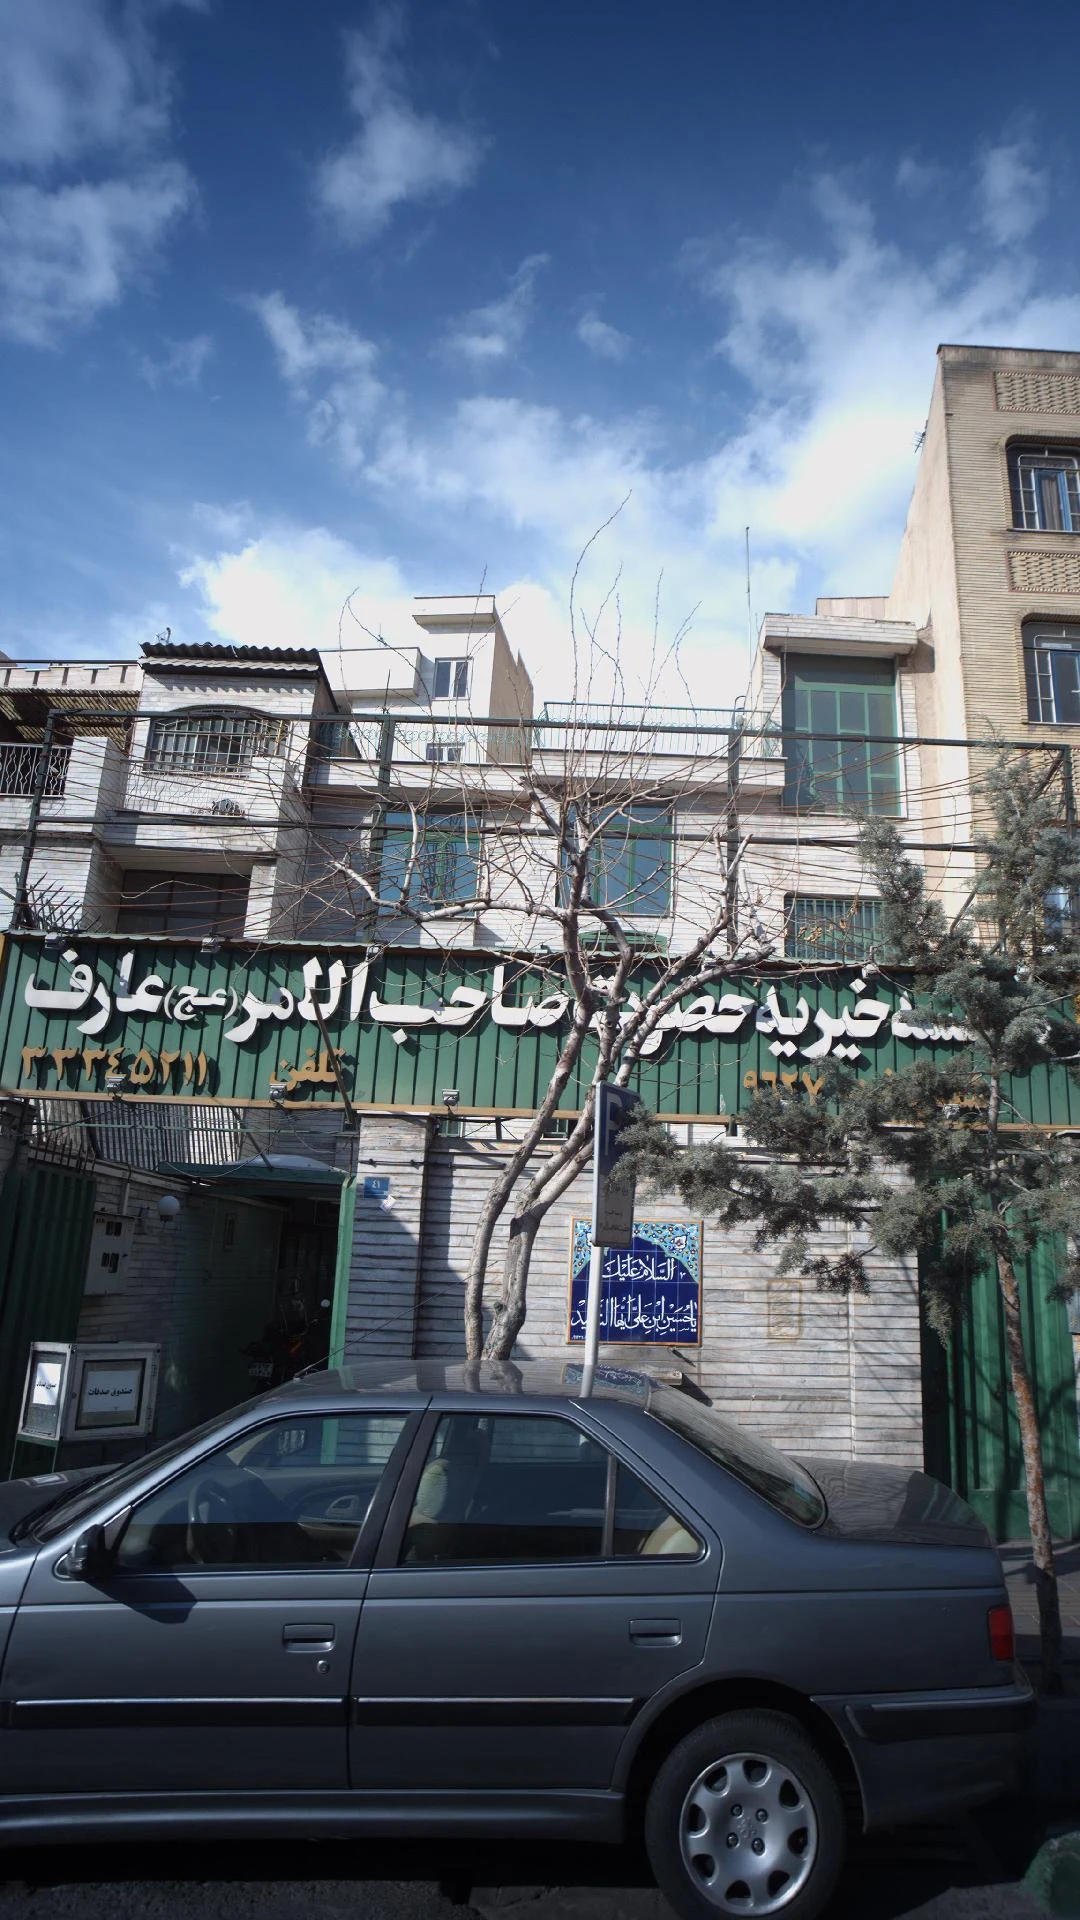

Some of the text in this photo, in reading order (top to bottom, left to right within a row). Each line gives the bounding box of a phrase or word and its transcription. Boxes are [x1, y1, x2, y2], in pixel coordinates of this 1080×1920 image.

[24, 948, 165, 1035] عارف
[369, 965, 571, 1045] صاحب
[755, 978, 890, 1060] خیریه
[269, 1047, 346, 1091] تلفن
[604, 1091, 624, 1156] P
